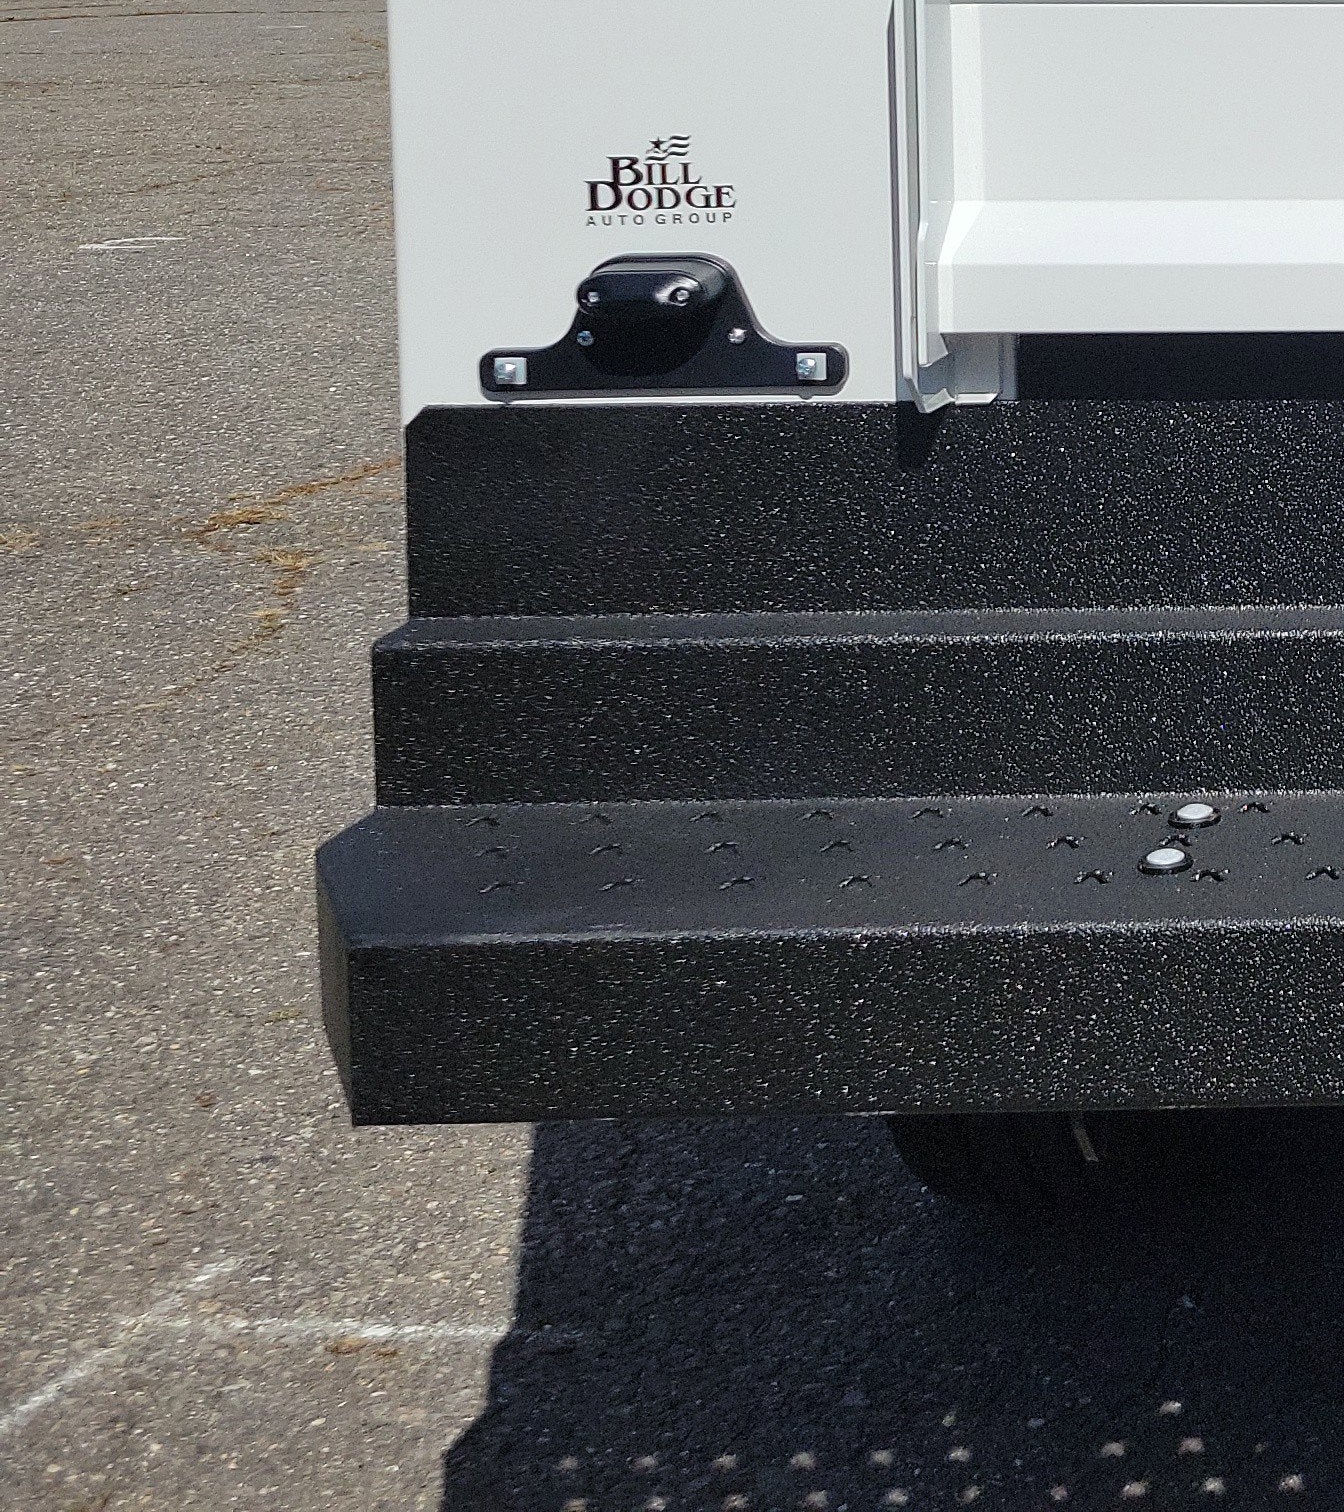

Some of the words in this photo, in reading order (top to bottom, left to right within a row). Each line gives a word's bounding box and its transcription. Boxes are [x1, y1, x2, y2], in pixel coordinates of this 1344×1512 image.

[605, 156, 703, 186] BILL
[585, 180, 737, 211] DODGE
[586, 214, 644, 226] AUTO
[655, 212, 732, 224] GROUP
